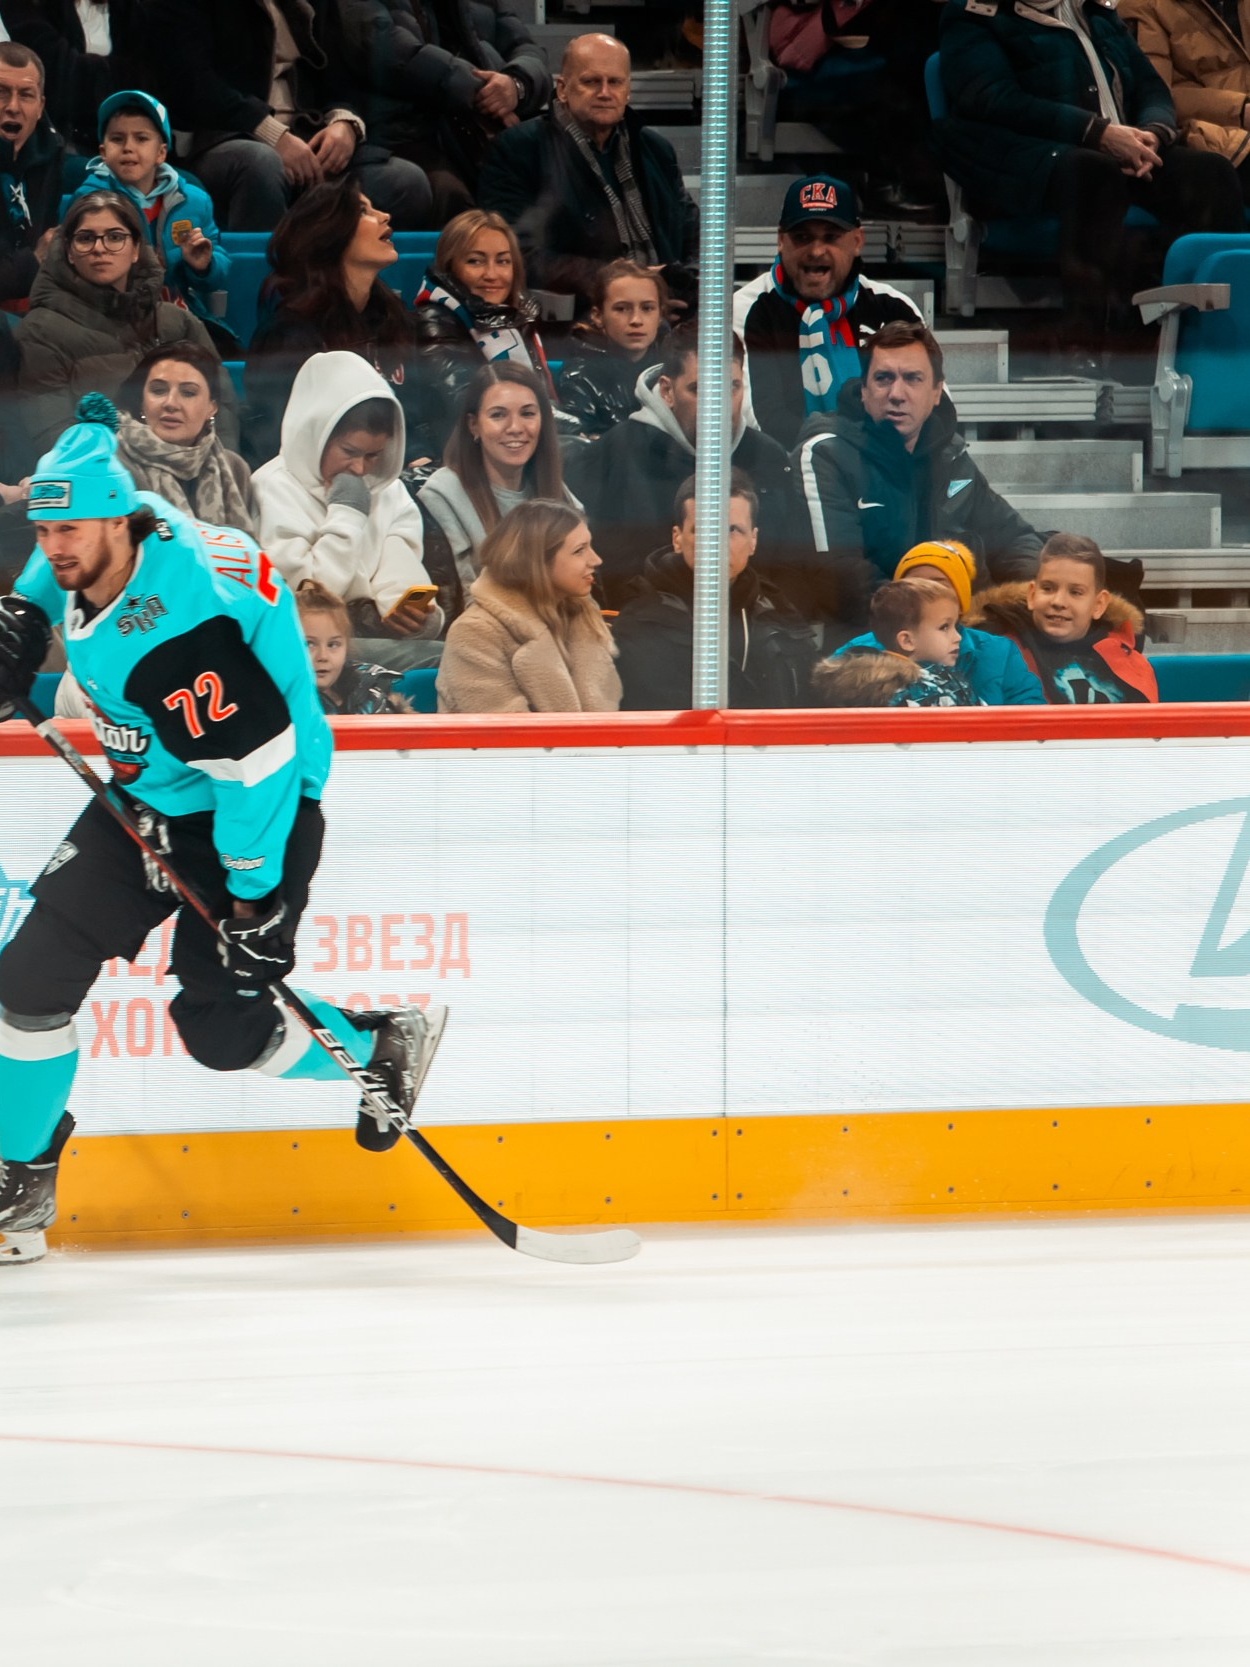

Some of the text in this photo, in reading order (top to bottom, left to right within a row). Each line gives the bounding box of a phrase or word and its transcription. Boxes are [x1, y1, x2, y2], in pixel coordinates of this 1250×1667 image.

[799, 182, 838, 206] СКА
[162, 671, 239, 739] 72
[312, 912, 471, 979] ЗВЕЗД
